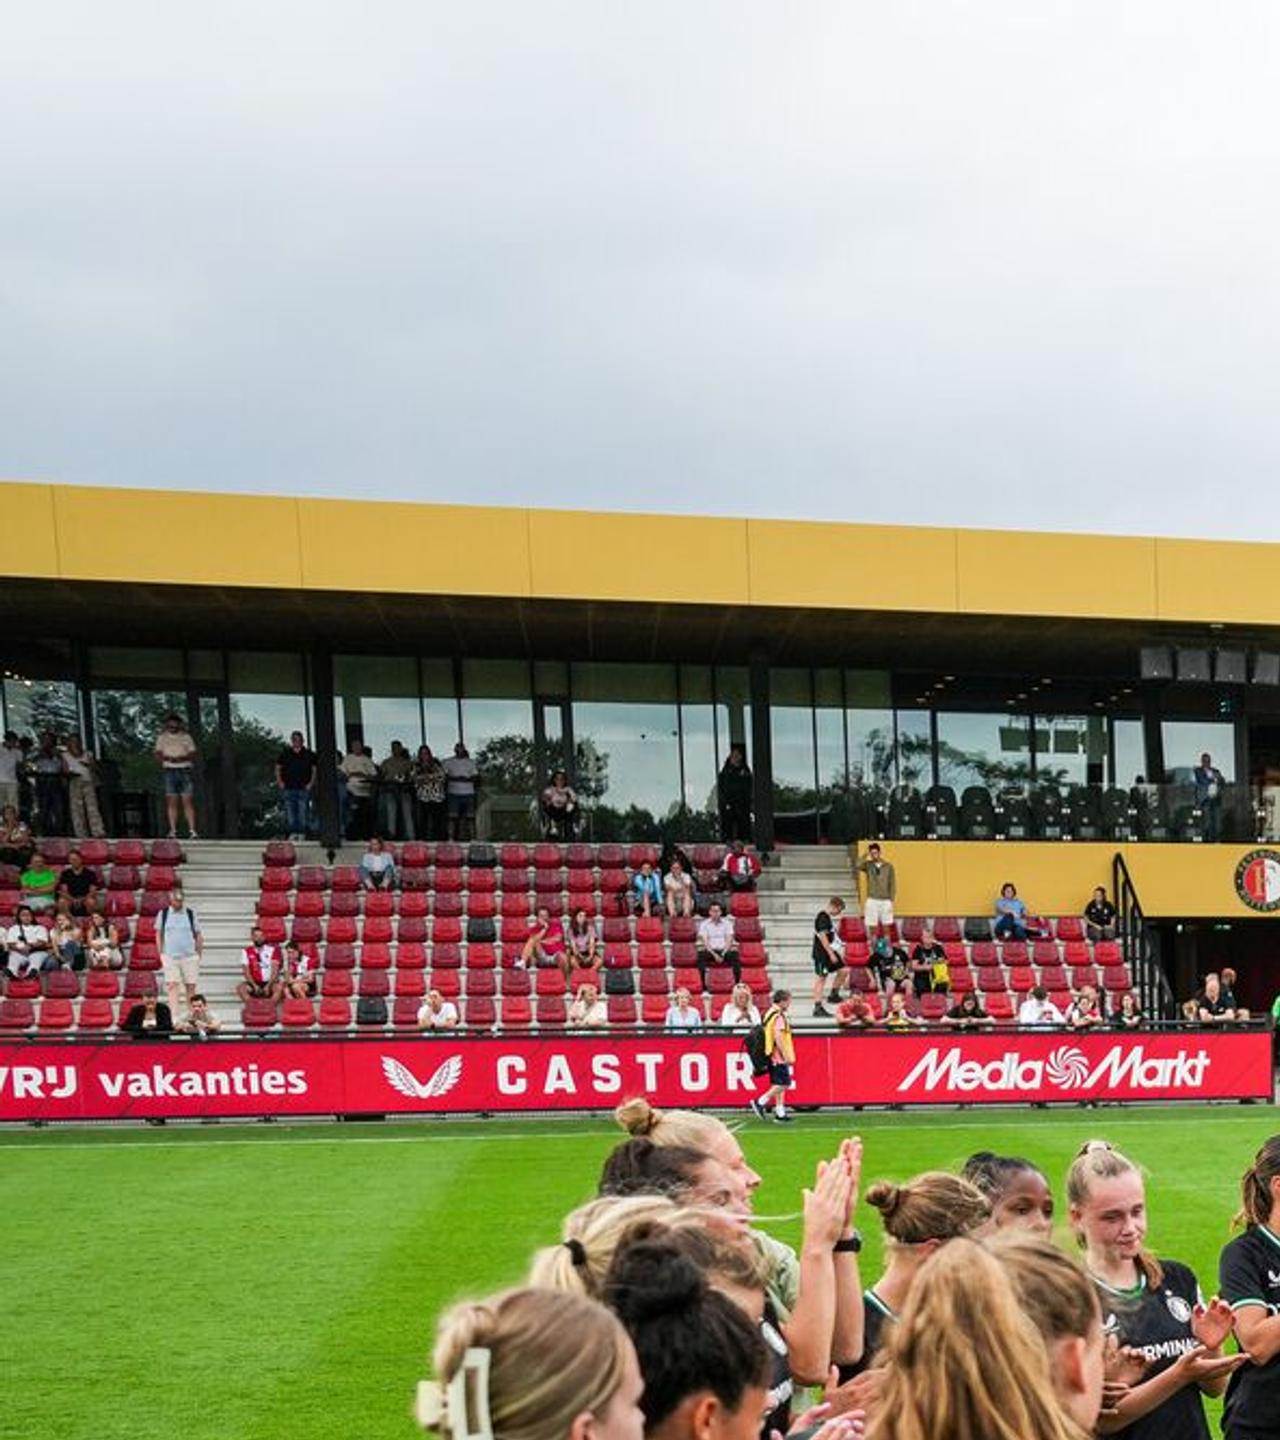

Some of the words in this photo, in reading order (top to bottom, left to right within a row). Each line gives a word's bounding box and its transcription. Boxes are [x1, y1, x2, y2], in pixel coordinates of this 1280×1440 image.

[98, 1064, 308, 1097] vakanties
[496, 1052, 797, 1095] CASTOR
[897, 1048, 1044, 1090] Media
[1082, 1045, 1211, 1089] Markt
